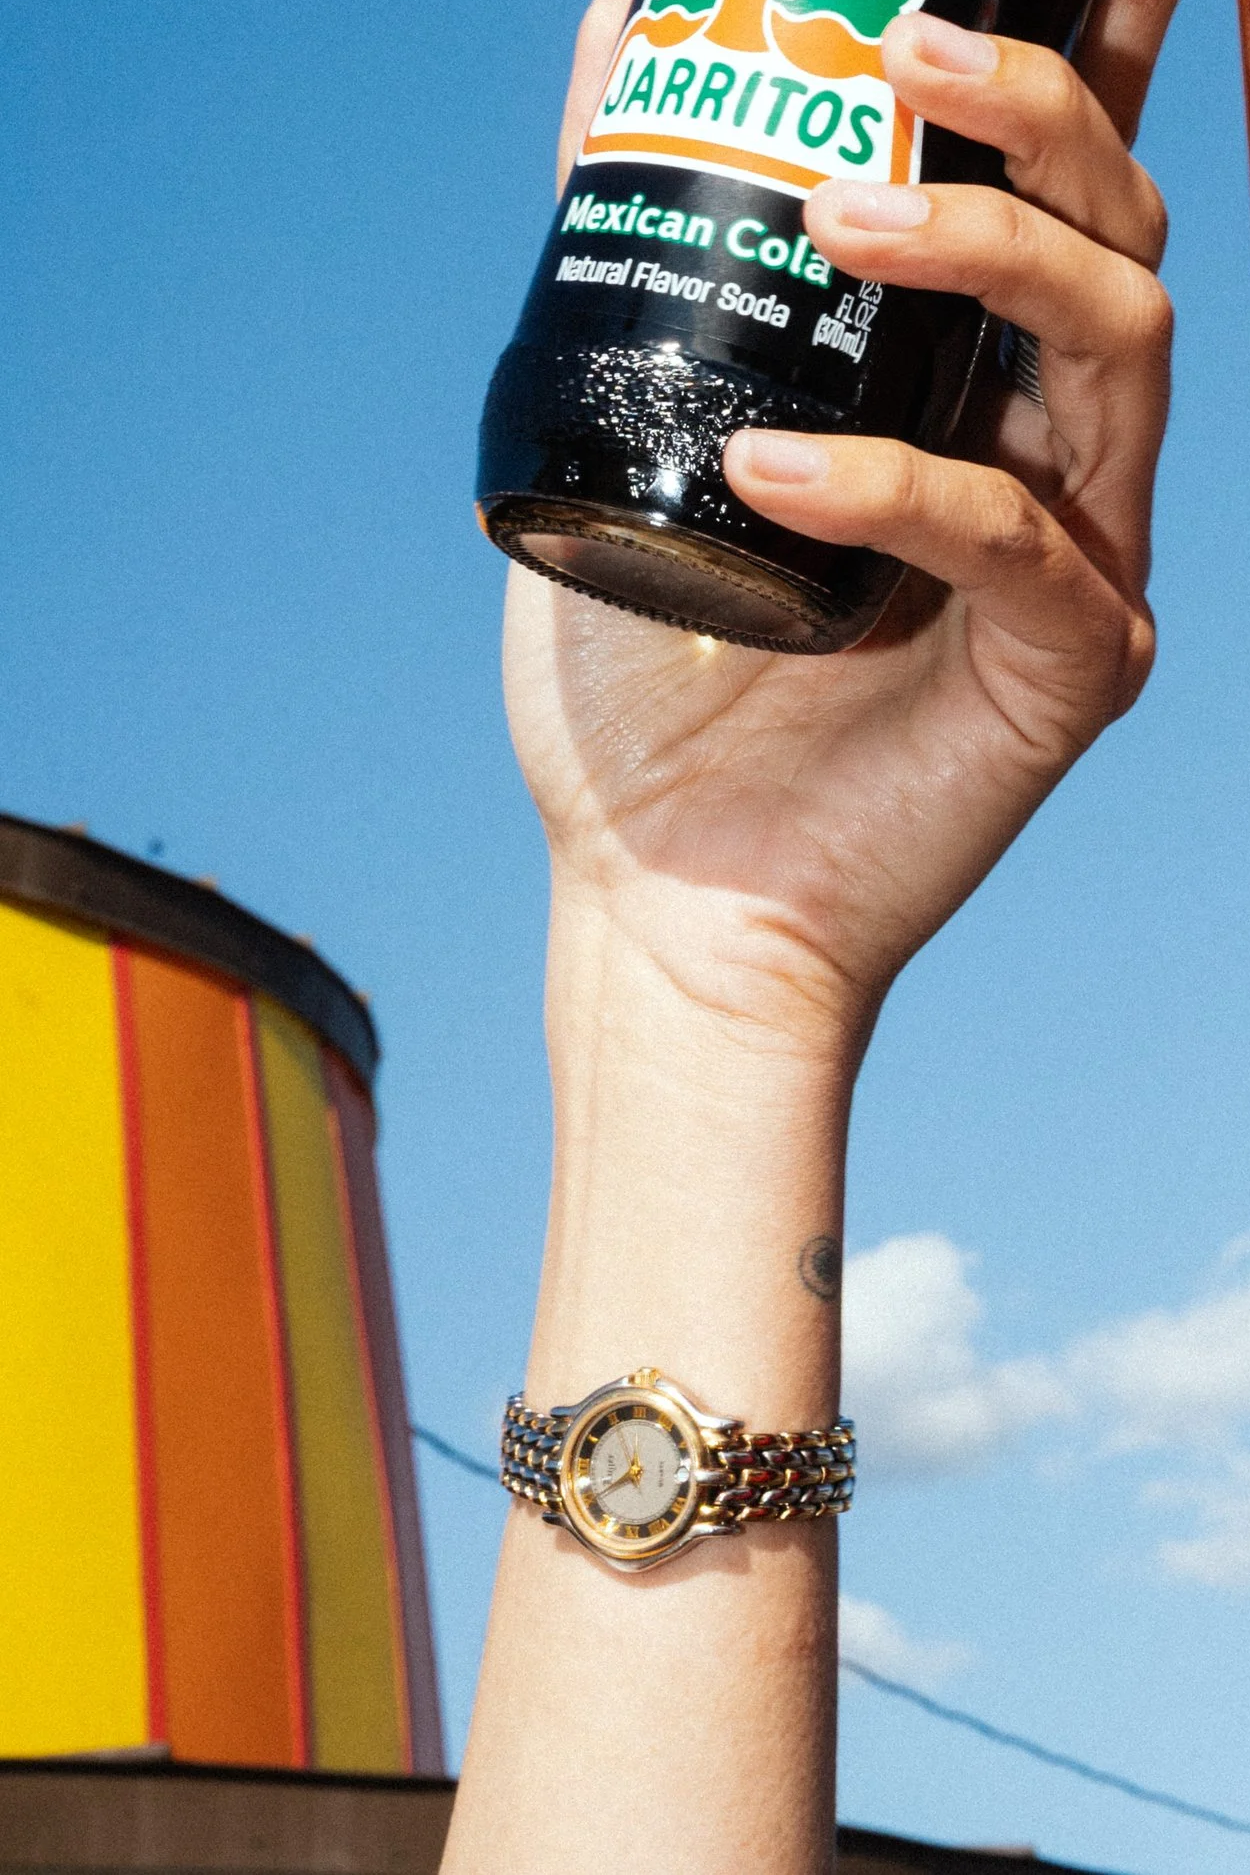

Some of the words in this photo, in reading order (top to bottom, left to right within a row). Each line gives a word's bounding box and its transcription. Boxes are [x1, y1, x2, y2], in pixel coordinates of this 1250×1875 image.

[603, 56, 884, 166] JARRITOS
[560, 192, 716, 251] Mexican
[724, 216, 836, 290] Cola
[555, 254, 634, 287] Natural
[630, 260, 717, 304] Flavor
[715, 281, 792, 329] Soda
[834, 291, 856, 325] FL
[854, 301, 879, 333] OZ
